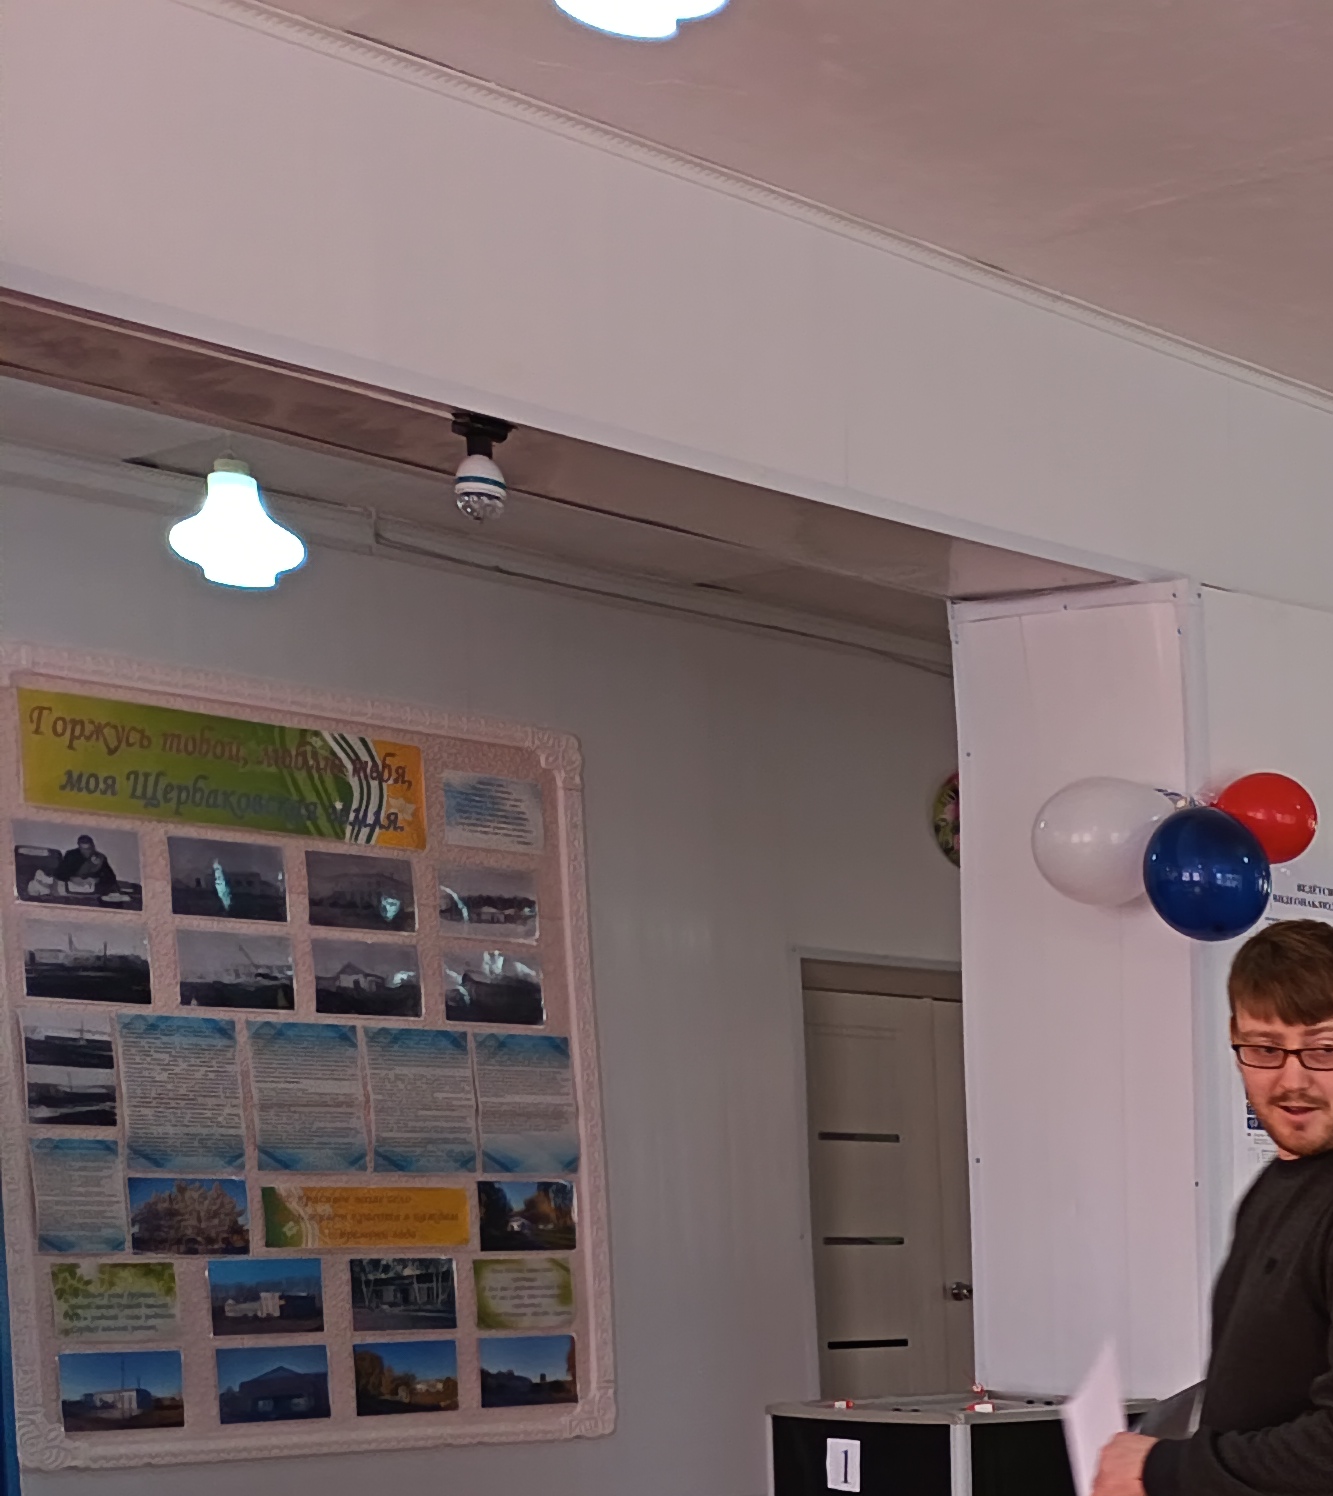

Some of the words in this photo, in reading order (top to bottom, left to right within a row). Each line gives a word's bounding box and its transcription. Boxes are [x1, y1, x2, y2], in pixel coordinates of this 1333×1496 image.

[29, 705, 152, 756] Горжусь
[161, 727, 249, 767] тобой,
[59, 768, 118, 797] моя
[840, 1448, 850, 1485] 1
